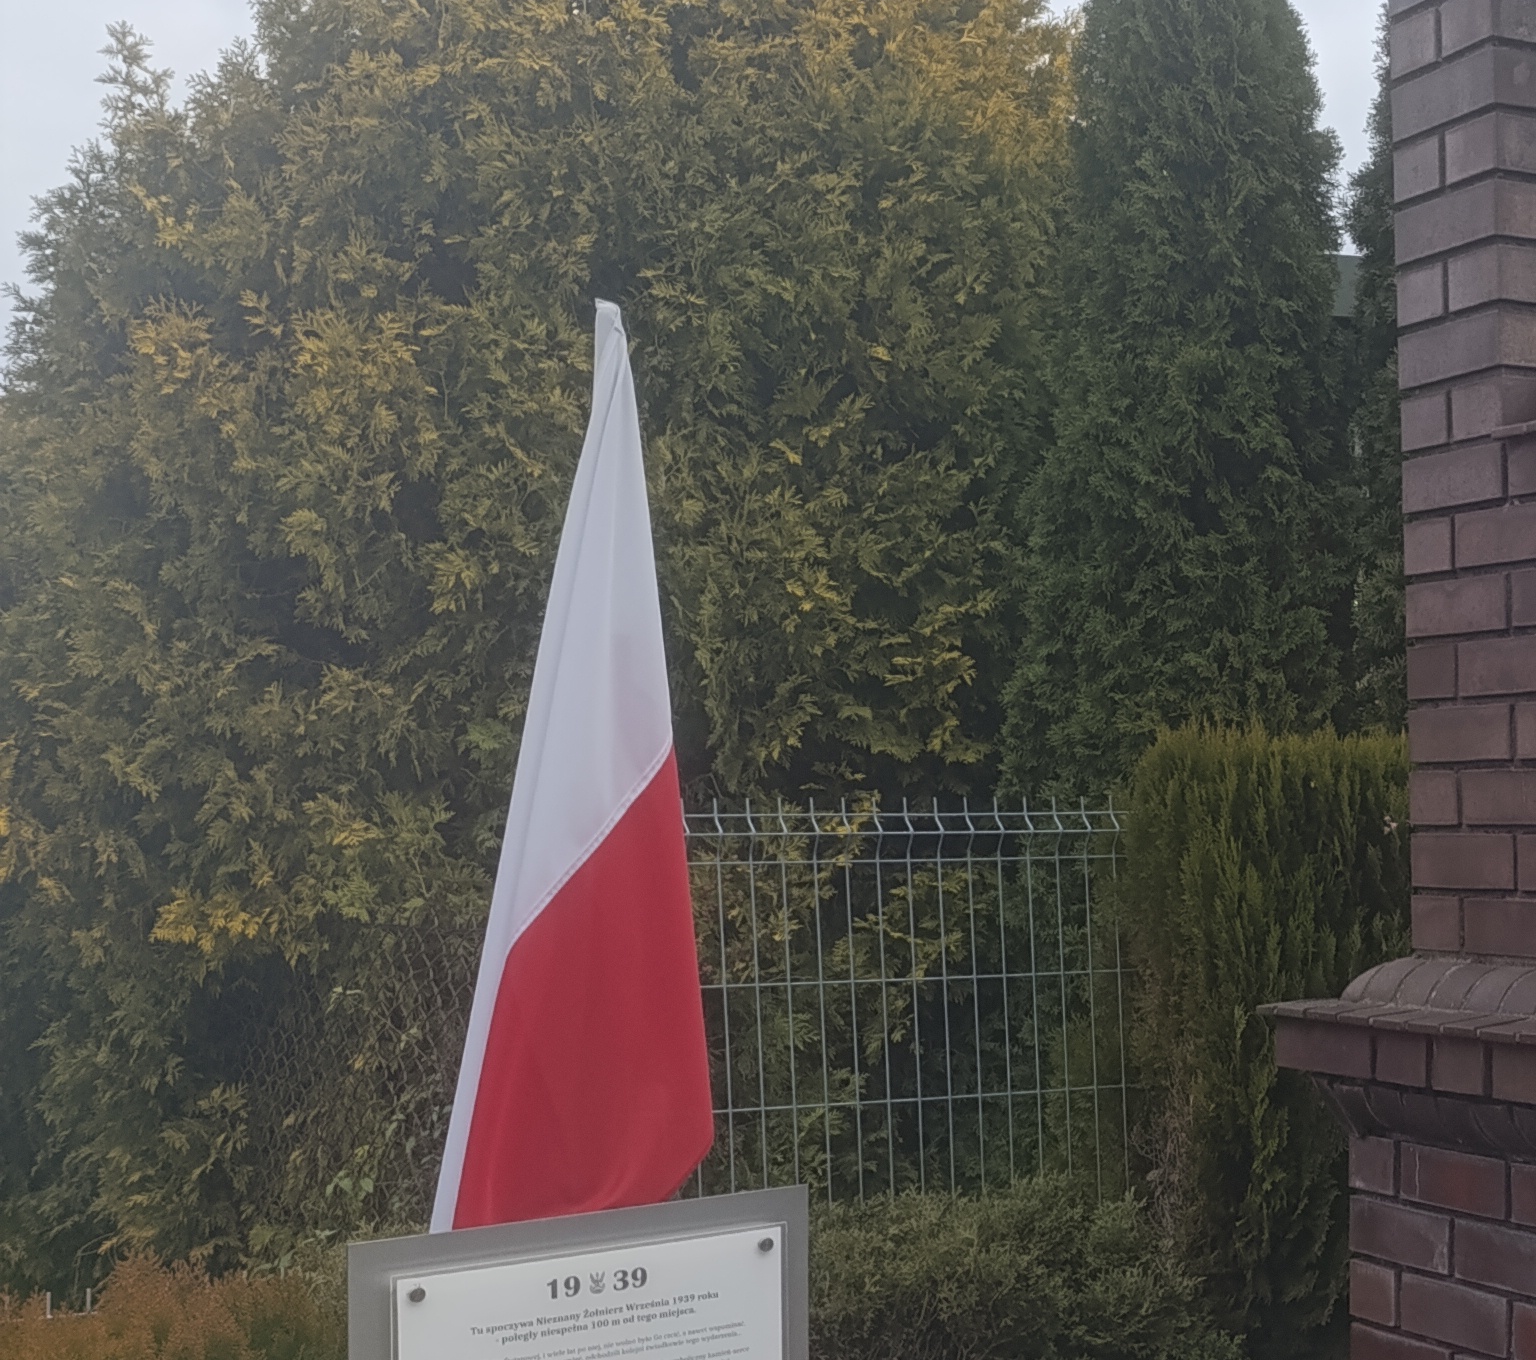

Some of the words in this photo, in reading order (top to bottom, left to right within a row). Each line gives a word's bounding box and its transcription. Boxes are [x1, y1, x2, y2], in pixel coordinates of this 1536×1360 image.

[547, 1276, 580, 1299] 19
[614, 1267, 647, 1291] 39
[470, 1327, 483, 1335] Tu
[486, 1321, 533, 1334] spoczywa
[536, 1314, 580, 1325] Nieznany
[673, 1294, 695, 1304] 1939
[698, 1291, 719, 1300] roku
[502, 1331, 538, 1345] poległy
[541, 1324, 588, 1337] niespełna
[592, 1319, 609, 1329] 100
[623, 1315, 634, 1324] od
[637, 1313, 657, 1322] tego
